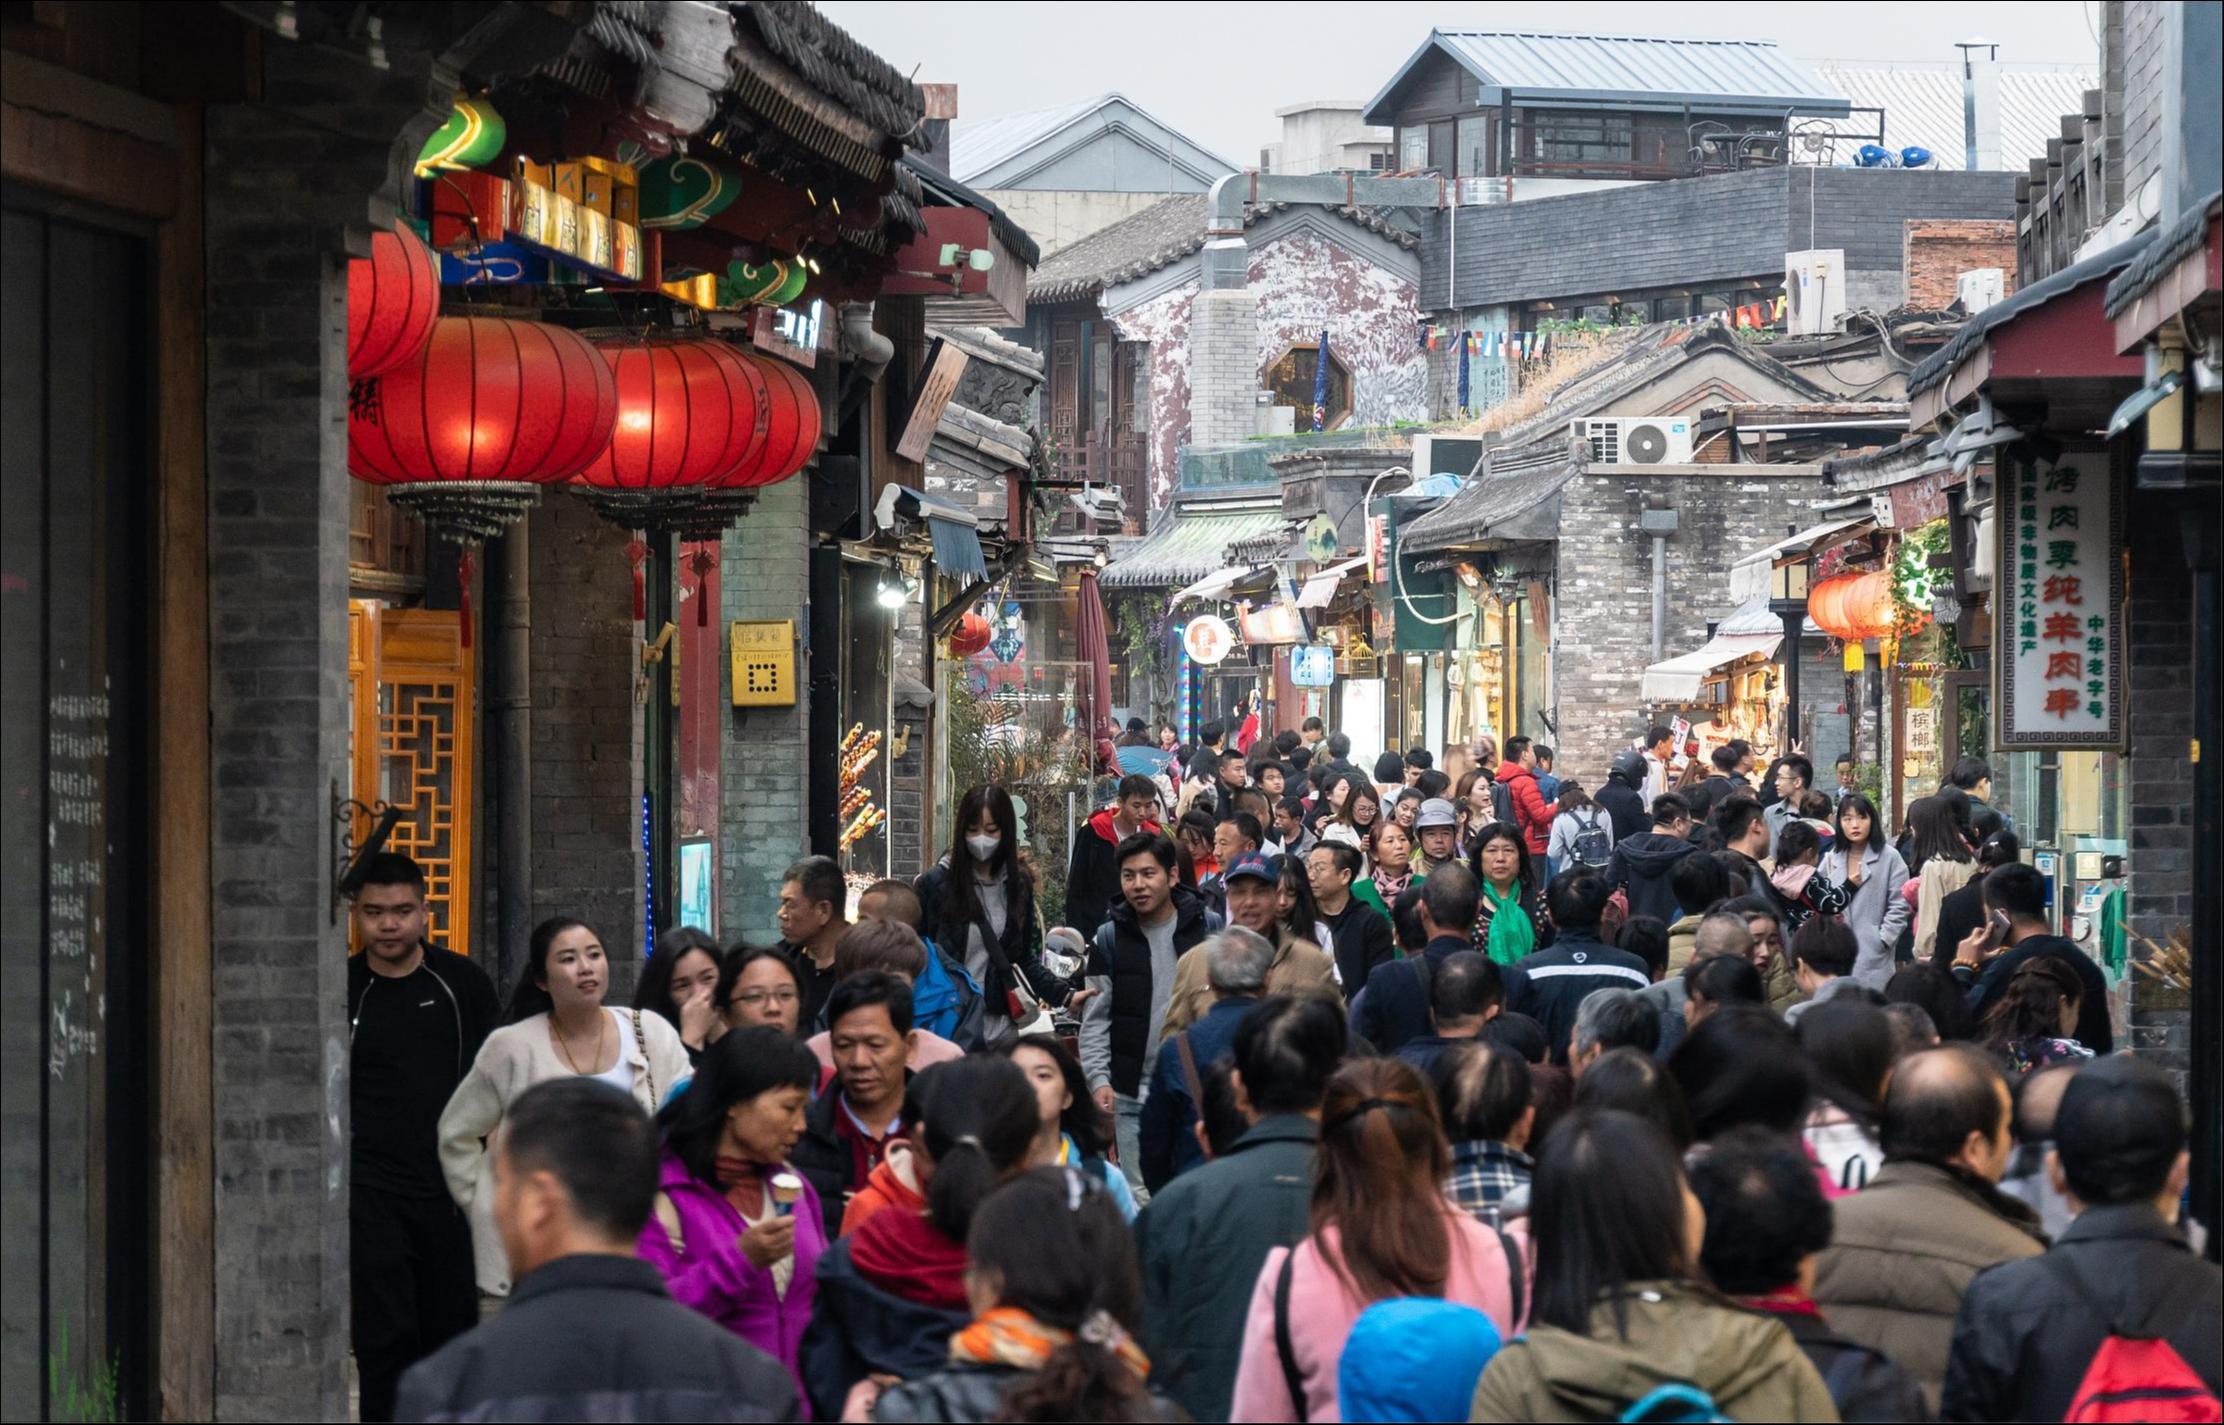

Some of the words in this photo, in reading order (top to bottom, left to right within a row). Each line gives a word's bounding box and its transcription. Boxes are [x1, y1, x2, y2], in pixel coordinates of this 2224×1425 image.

[2087, 614, 2105, 719] 中华老字号
[1912, 712, 1930, 748] 槟榔
